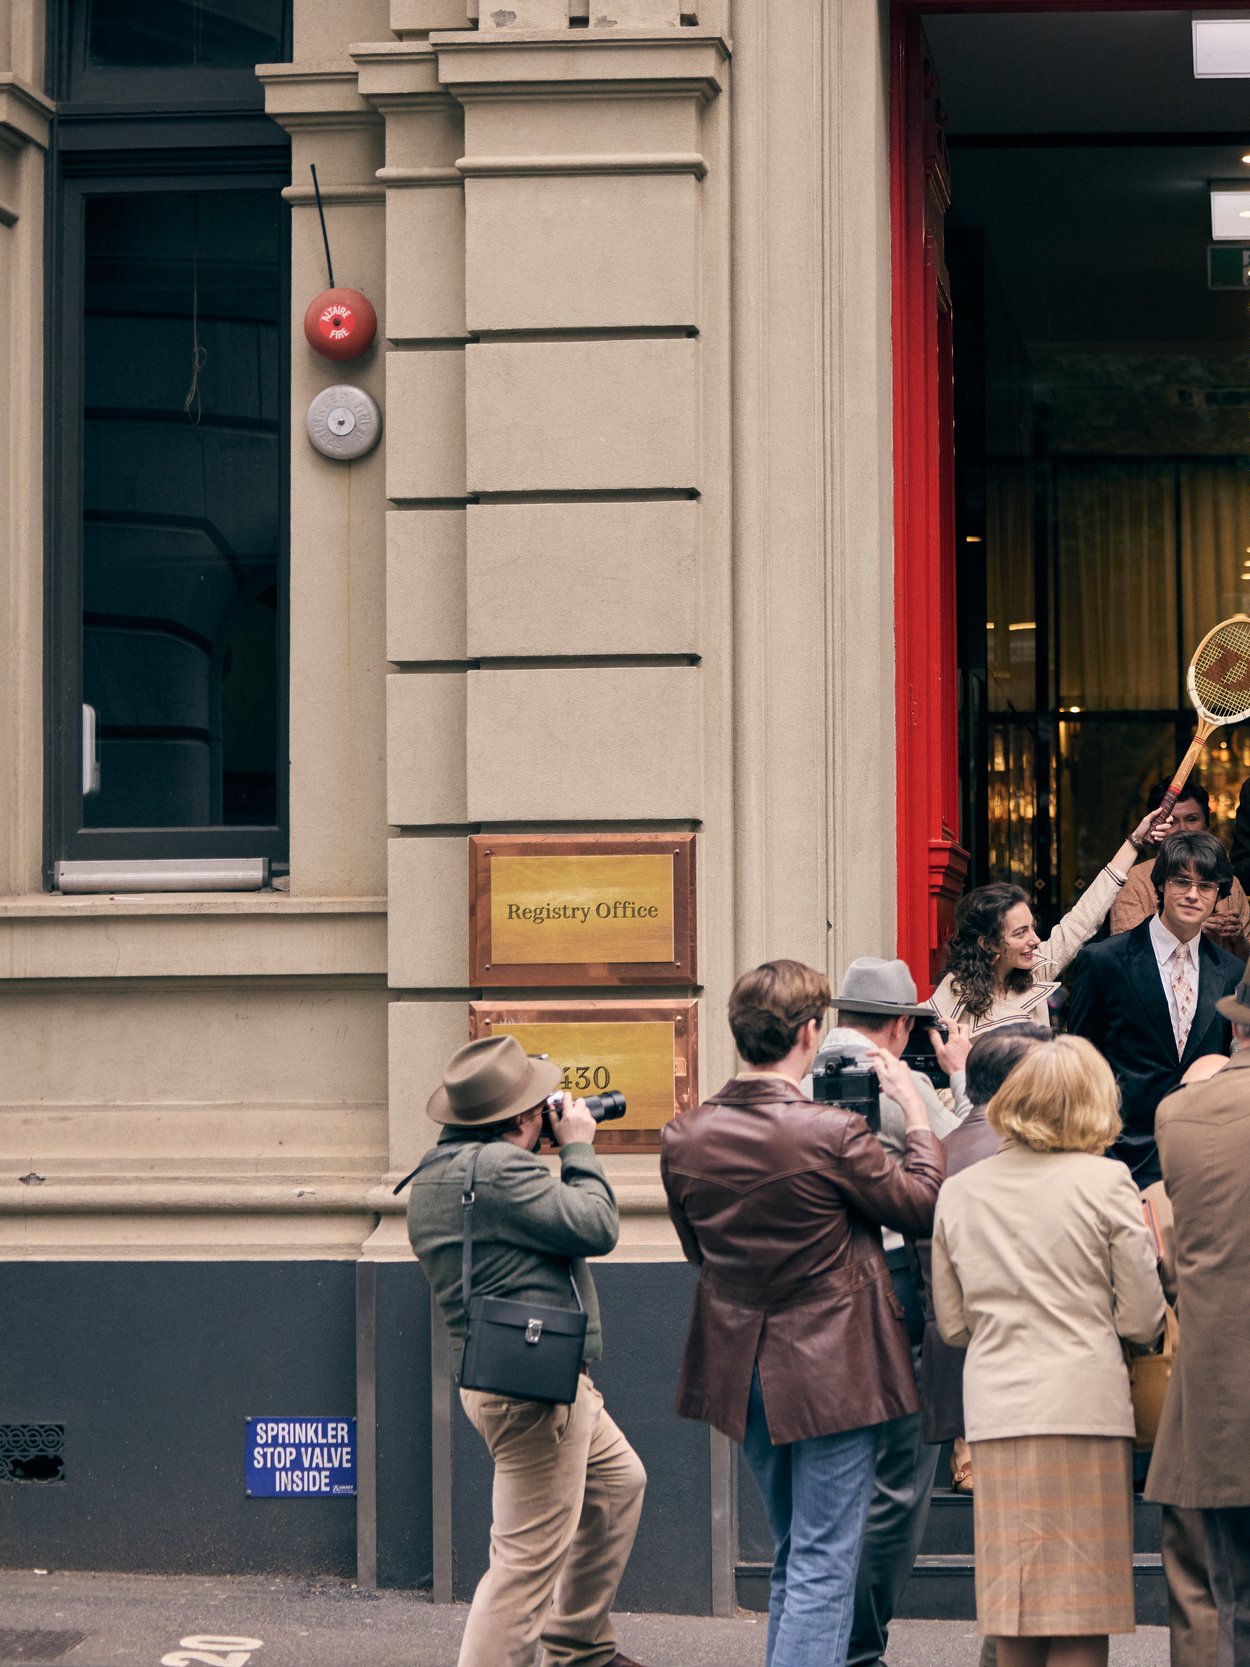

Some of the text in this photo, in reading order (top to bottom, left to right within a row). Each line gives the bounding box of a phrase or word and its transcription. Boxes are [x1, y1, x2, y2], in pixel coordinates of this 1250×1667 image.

[321, 306, 351, 322] ALTAIRE
[330, 327, 350, 339] FIRE
[507, 901, 659, 924] Registry Office
[256, 1422, 349, 1444] SPRINKLER
[253, 1446, 352, 1468] STOP VALVE
[275, 1470, 330, 1492] INSIDE
